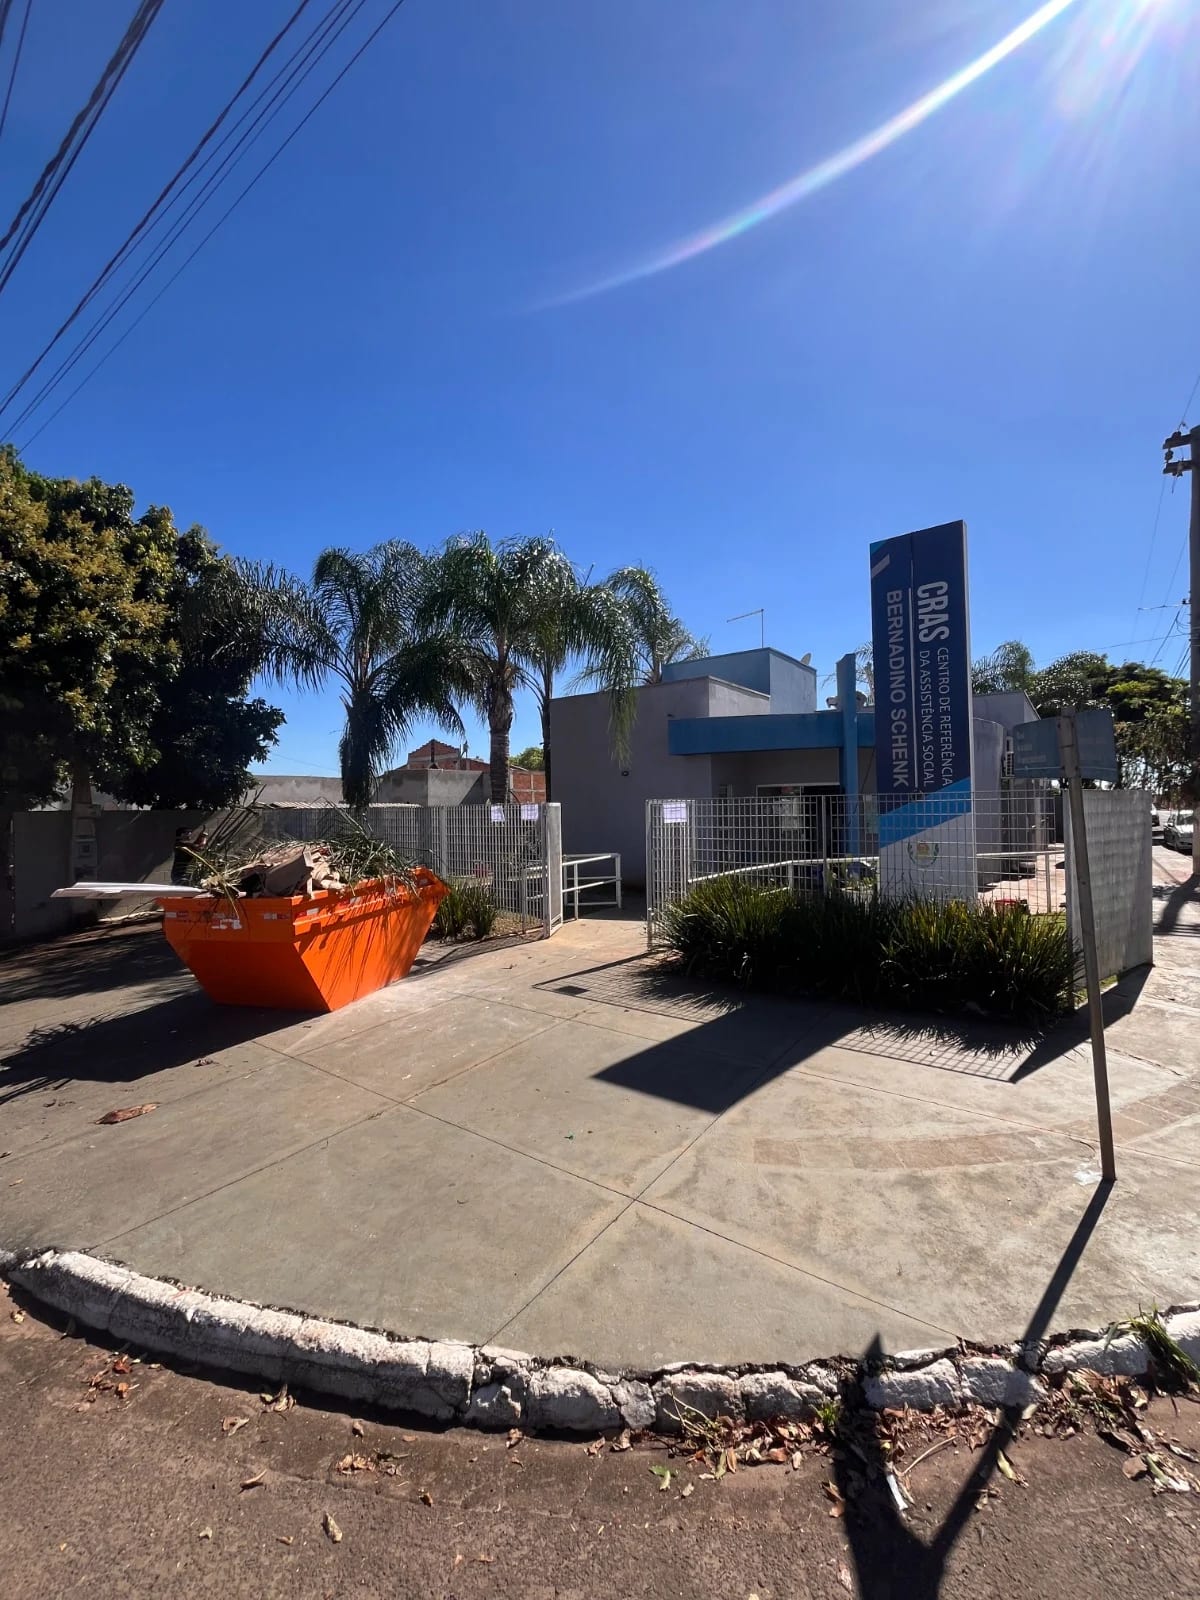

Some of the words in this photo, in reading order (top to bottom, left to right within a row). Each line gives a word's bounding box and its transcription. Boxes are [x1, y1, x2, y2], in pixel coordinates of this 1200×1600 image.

[917, 581, 950, 643] CRAS
[887, 590, 906, 702] BERNADINO
[919, 650, 930, 668] DA
[937, 647, 950, 694] CENTRO
[920, 669, 935, 743] ASSISTÊNCIA
[939, 697, 951, 712] DE
[890, 708, 909, 788] SCHENK
[922, 744, 934, 787] SOCIAL
[940, 715, 955, 787] REFERÊNCIA
